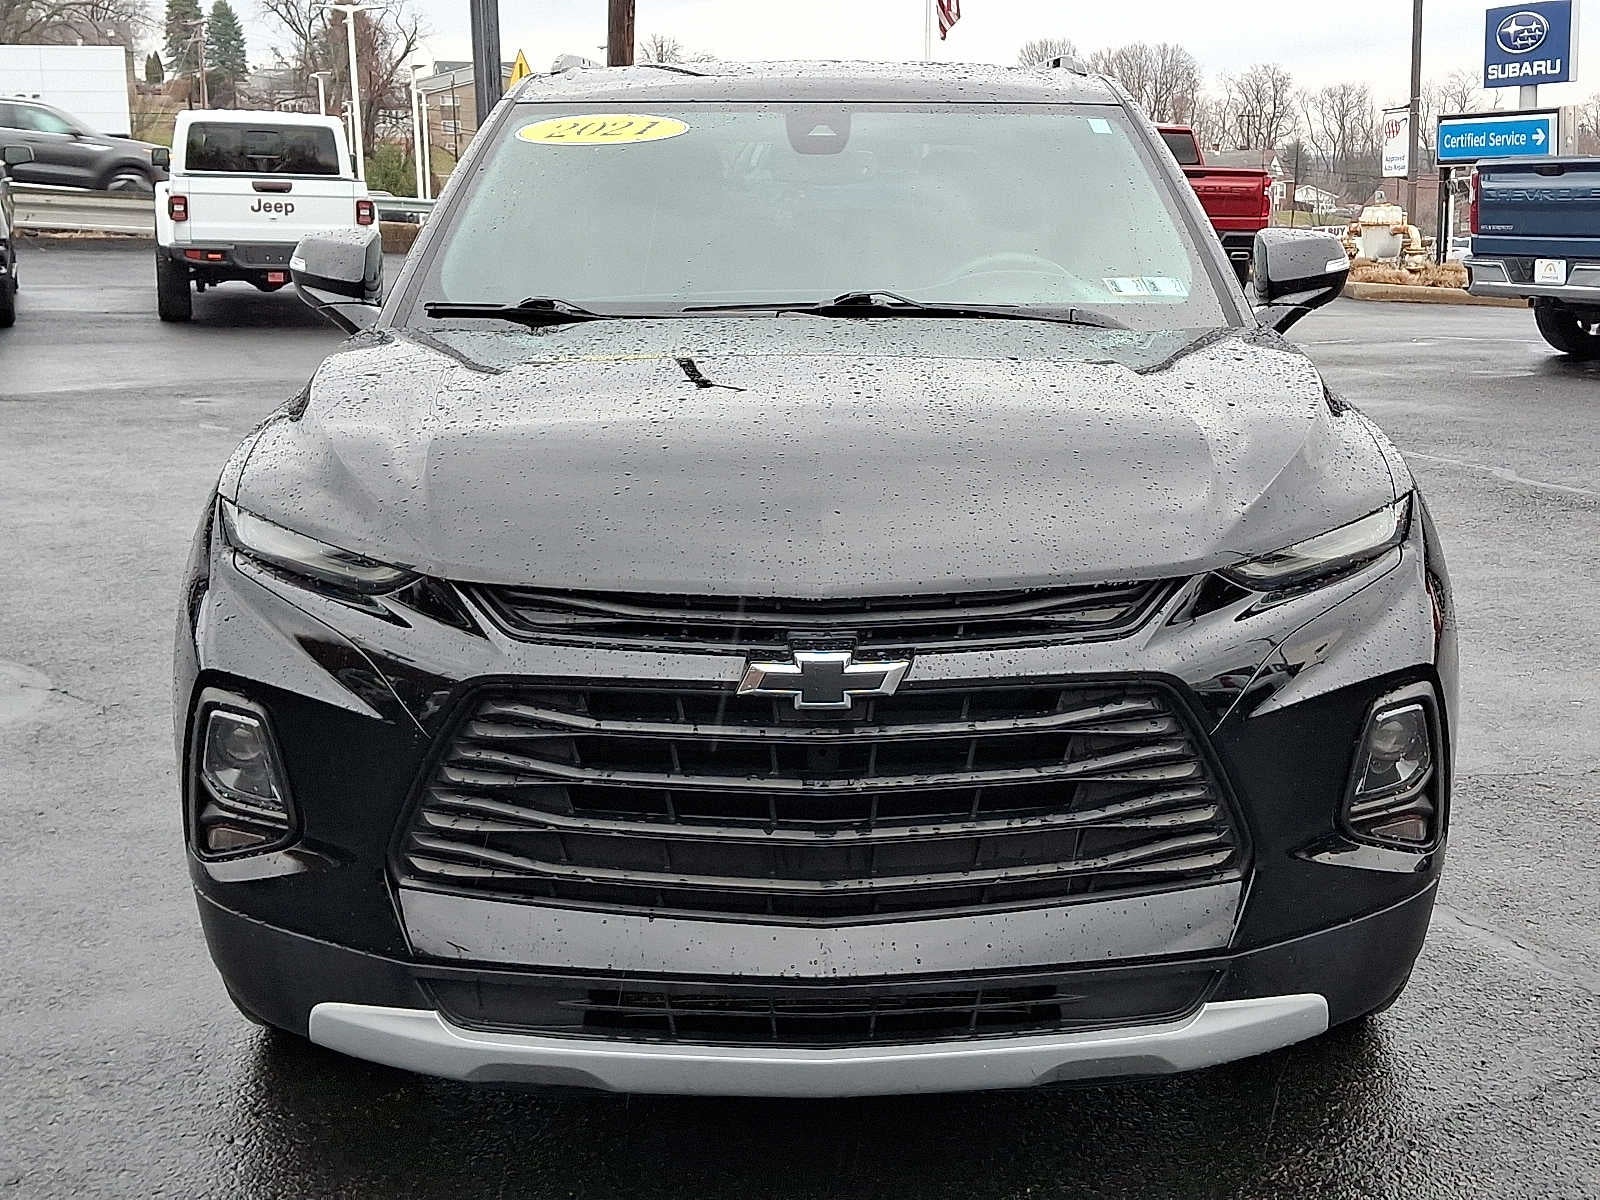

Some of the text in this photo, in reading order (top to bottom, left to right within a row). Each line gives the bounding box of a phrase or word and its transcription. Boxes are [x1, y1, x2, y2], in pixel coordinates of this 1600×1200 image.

[1487, 58, 1561, 80] SUBARU
[543, 120, 661, 139] 2021
[1443, 130, 1527, 148] Certified Service
[250, 198, 295, 216] Jeep
